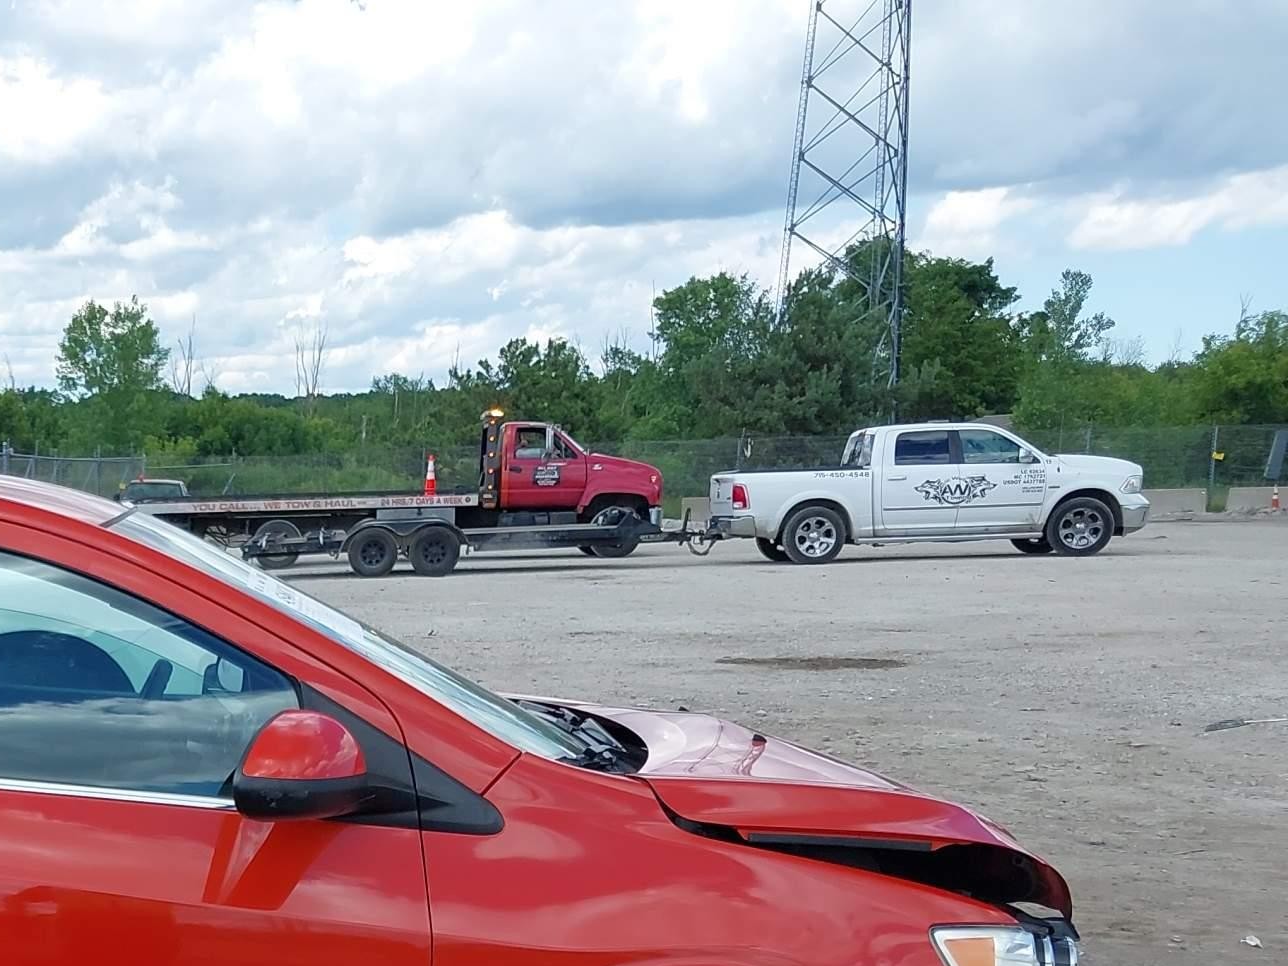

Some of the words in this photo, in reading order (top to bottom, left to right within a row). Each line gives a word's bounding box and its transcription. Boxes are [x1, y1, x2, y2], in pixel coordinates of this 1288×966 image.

[192, 503, 216, 512] YOU
[264, 501, 282, 510] WE
[287, 501, 310, 510] TOW
[324, 499, 357, 508] HAUL
[381, 498, 390, 507] 24
[416, 497, 434, 505] DAYS
[437, 496, 442, 504] A
[444, 495, 463, 504] WEEK
